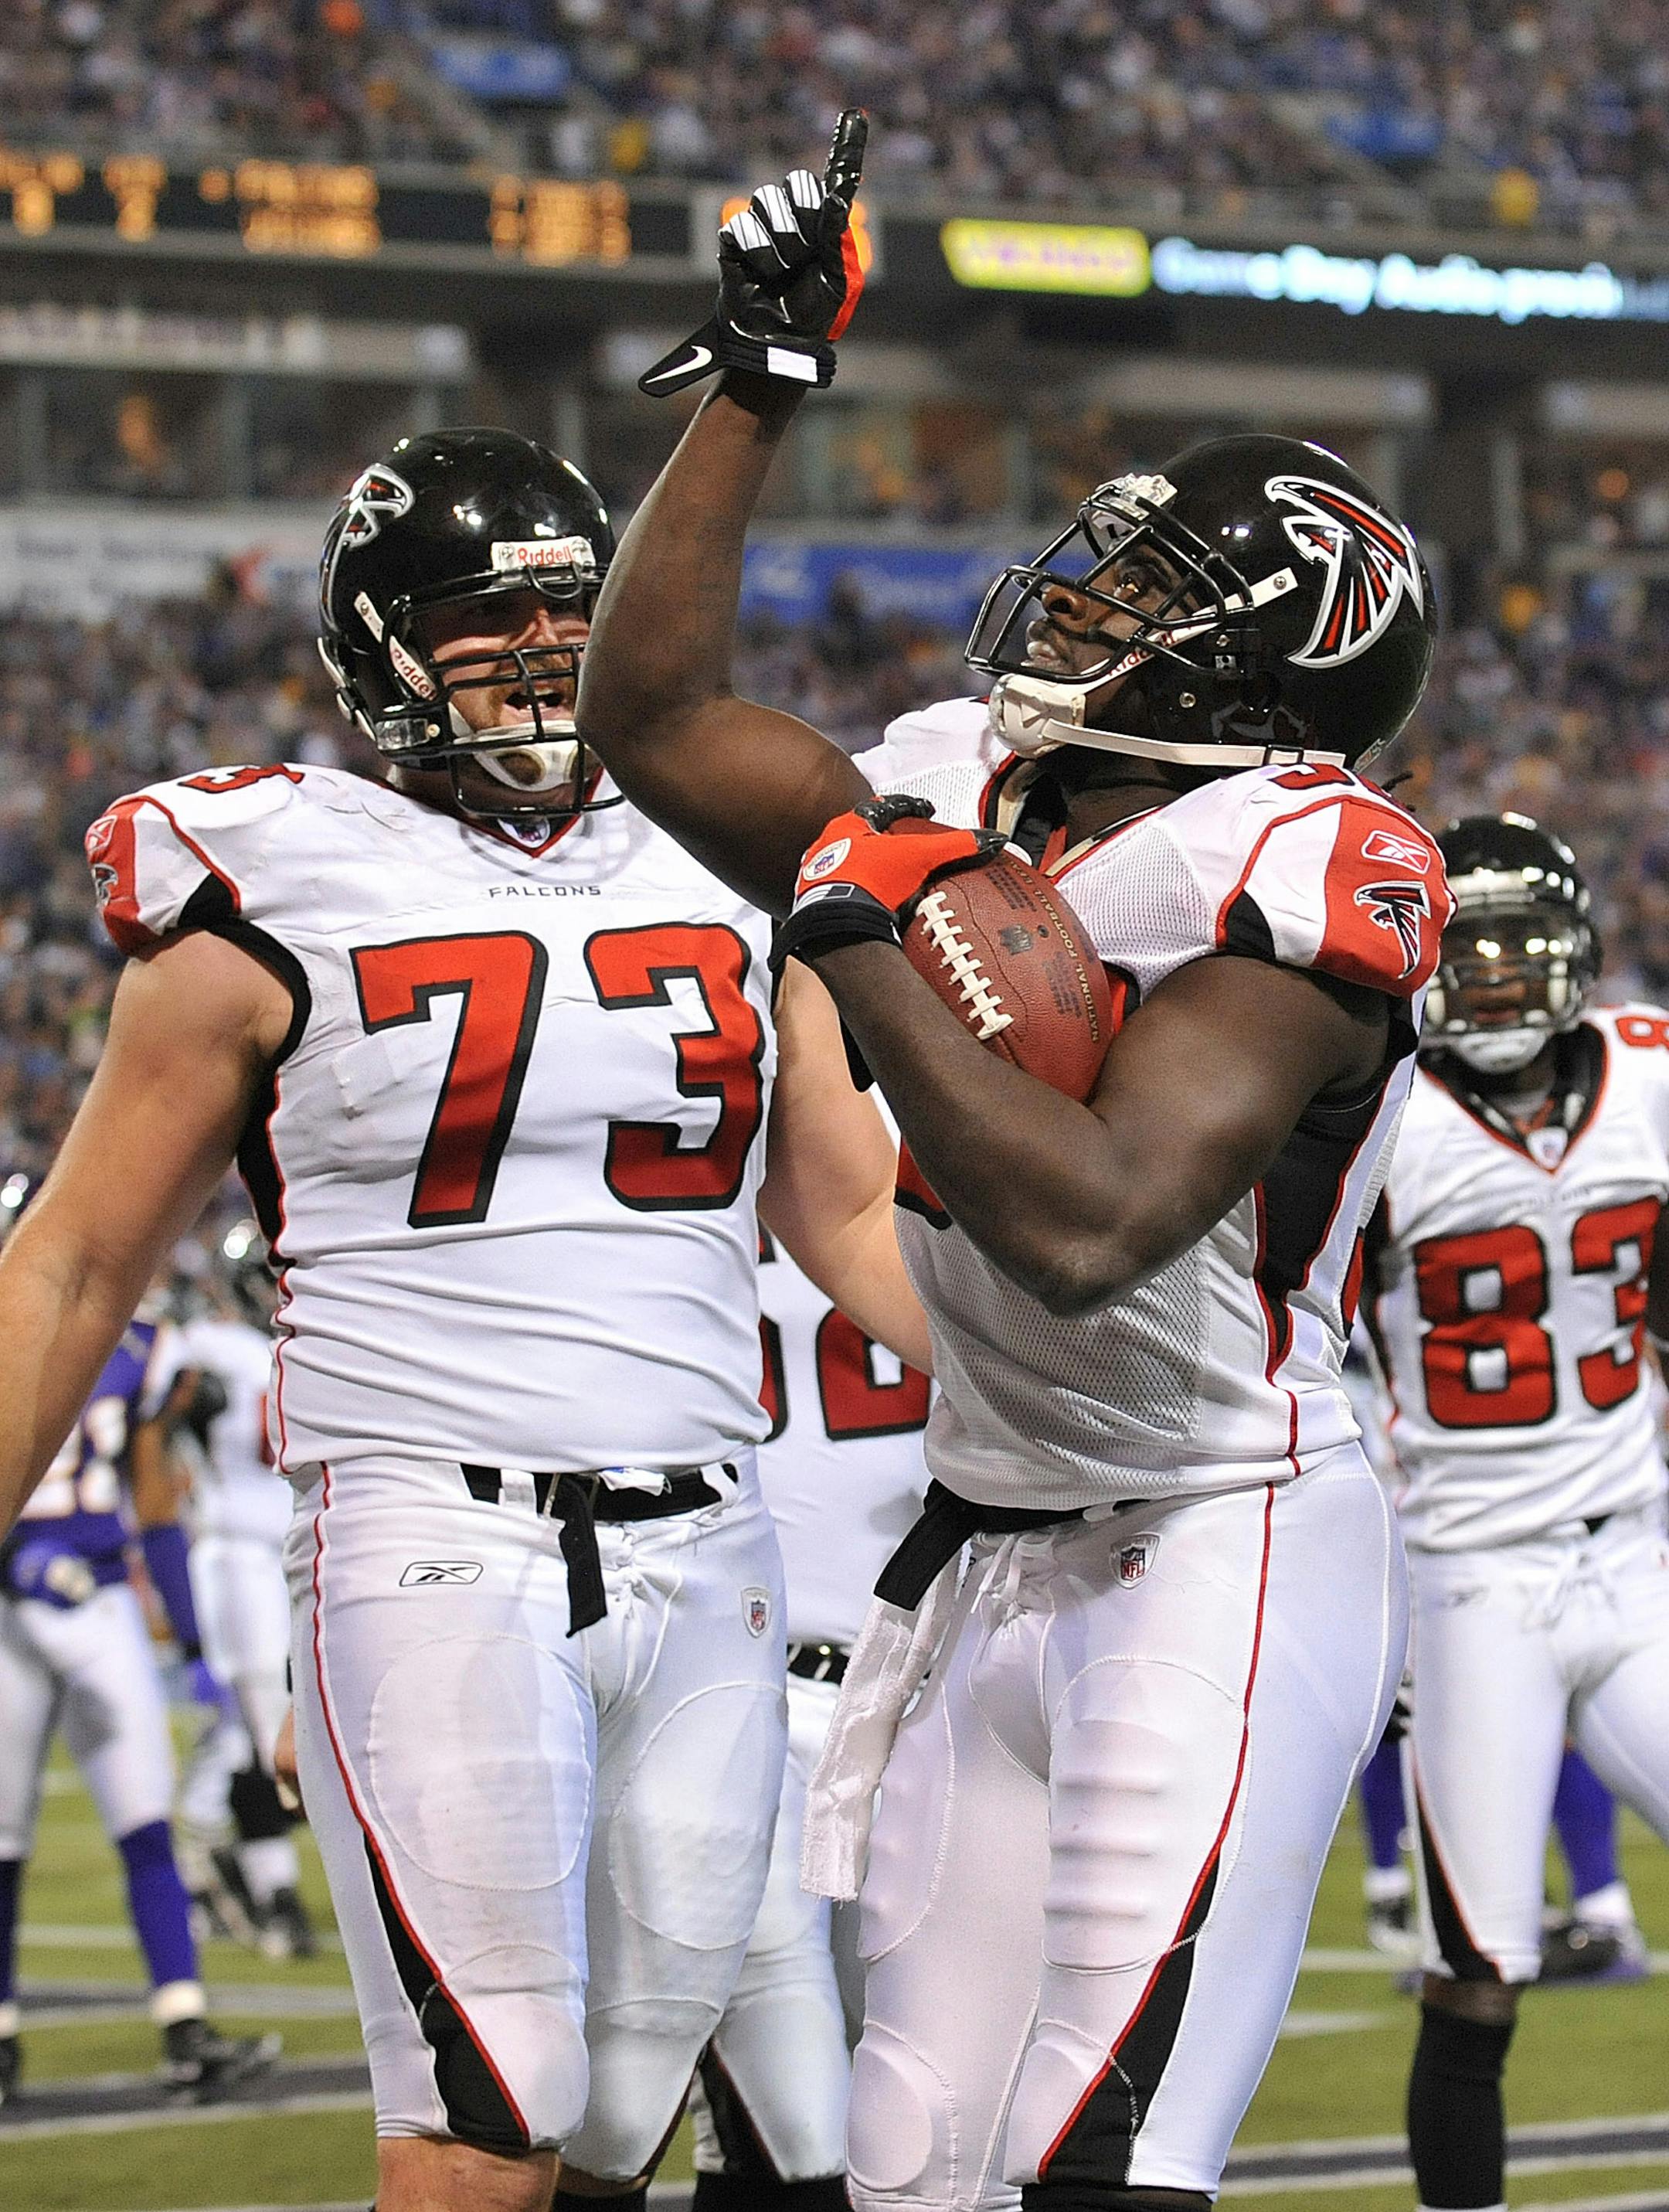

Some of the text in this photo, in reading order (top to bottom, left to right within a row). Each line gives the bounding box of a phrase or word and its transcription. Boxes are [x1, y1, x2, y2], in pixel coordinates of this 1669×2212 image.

[517, 546, 572, 567] Riddell
[488, 886, 602, 898] FALCONS
[1034, 889, 1078, 958] FOOTBALL
[1075, 963, 1100, 1042] NATIONAL
[348, 921, 766, 1230] 73
[1413, 1195, 1661, 1429] 83
